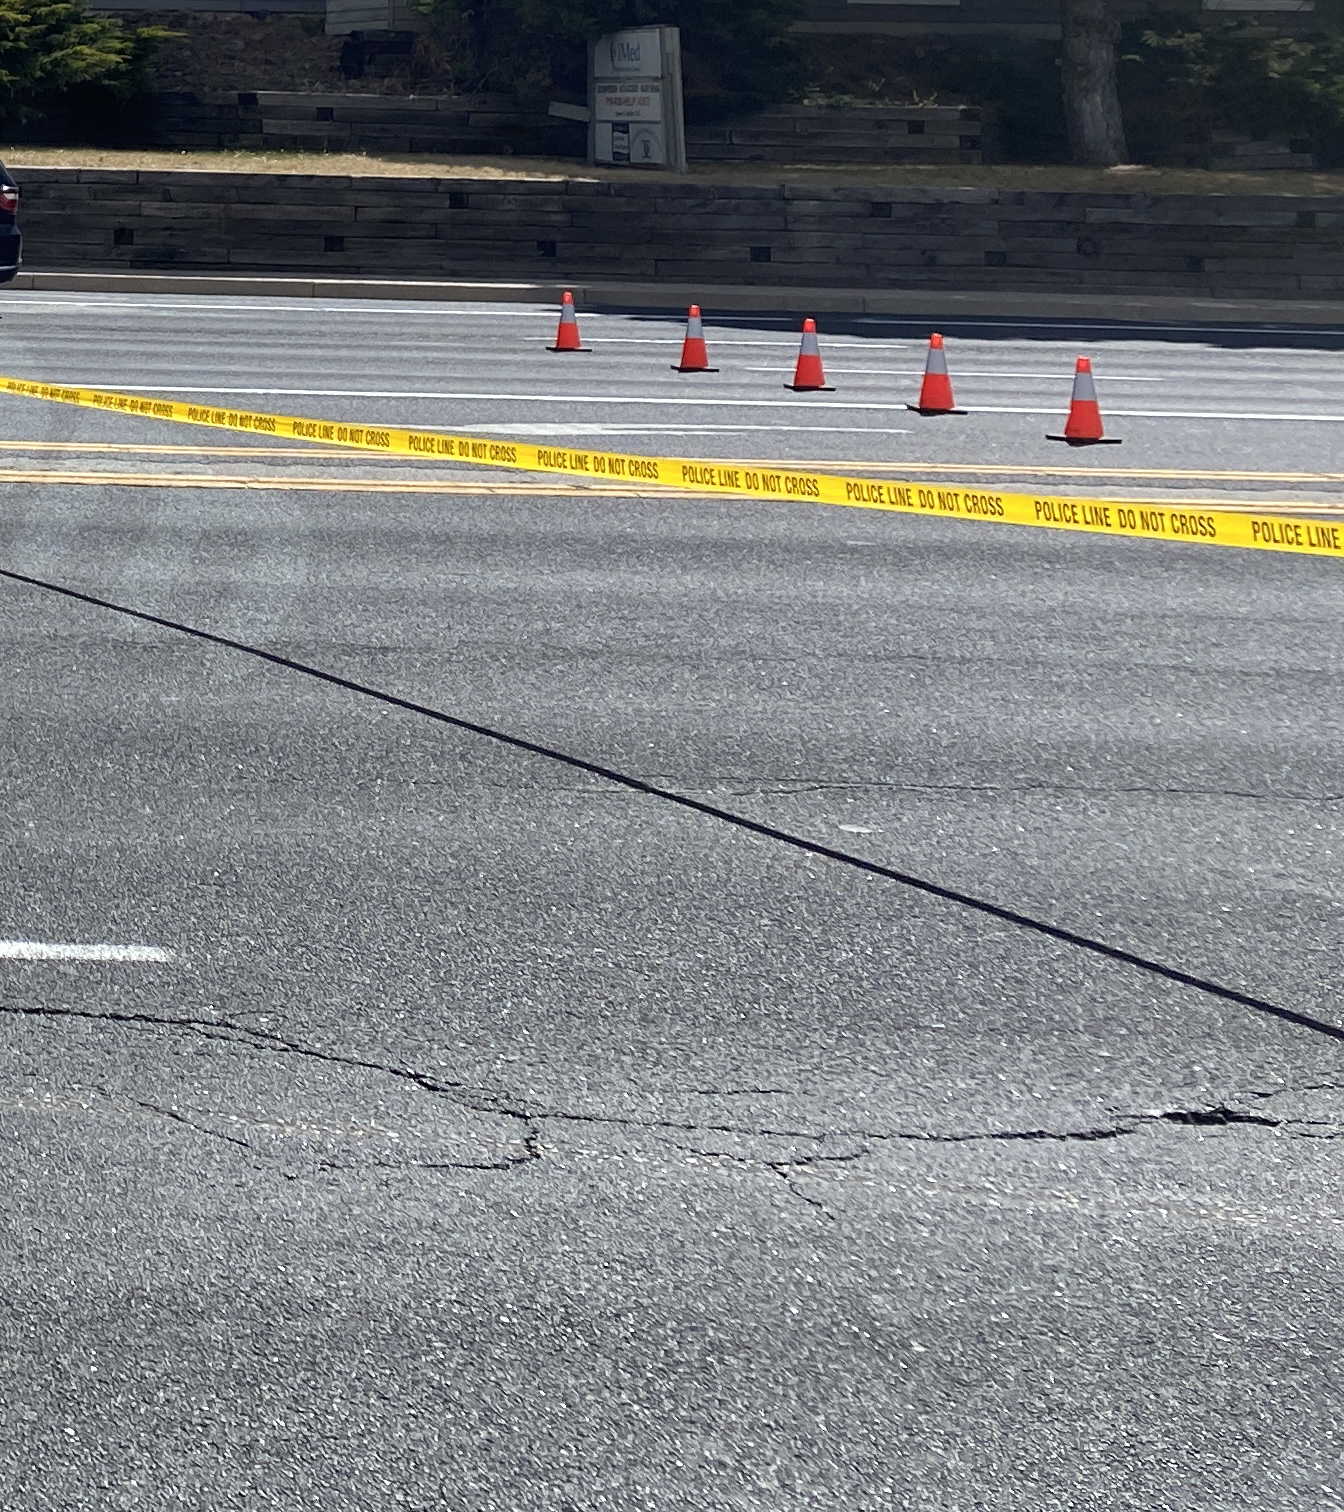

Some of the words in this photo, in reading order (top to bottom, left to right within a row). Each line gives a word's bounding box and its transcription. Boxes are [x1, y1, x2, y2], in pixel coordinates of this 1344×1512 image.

[293, 421, 317, 438] POLICE
[318, 424, 334, 440] LINE
[337, 427, 348, 442] DO
[349, 429, 364, 444] NOT
[365, 430, 390, 448] CROSS
[408, 434, 435, 452] POLICE
[437, 438, 454, 455] LINE
[458, 440, 469, 457] DO
[472, 442, 487, 459] NOT
[489, 444, 517, 463] CROSS
[537, 449, 567, 468] POLICE
[569, 453, 590, 471] LINE
[593, 456, 606, 474] DO
[608, 457, 626, 476] NOT
[629, 460, 658, 479] CROSS
[682, 465, 717, 486] POLICE
[718, 469, 741, 489] LINE
[745, 472, 759, 490] DO
[762, 475, 782, 493] NOT
[785, 476, 819, 497] CROSS
[846, 482, 885, 503] POLICE
[888, 486, 914, 507] LINE
[918, 489, 935, 509] DO
[938, 491, 960, 512] NOT
[964, 494, 1005, 517] CROSS
[1034, 500, 1078, 525] POLICE
[1082, 505, 1112, 527] LINE
[1118, 508, 1136, 529] DO
[1140, 511, 1166, 532] NOT
[1170, 513, 1217, 537] CROSS
[1252, 521, 1303, 546] POLICE
[1308, 526, 1341, 550] LINE
